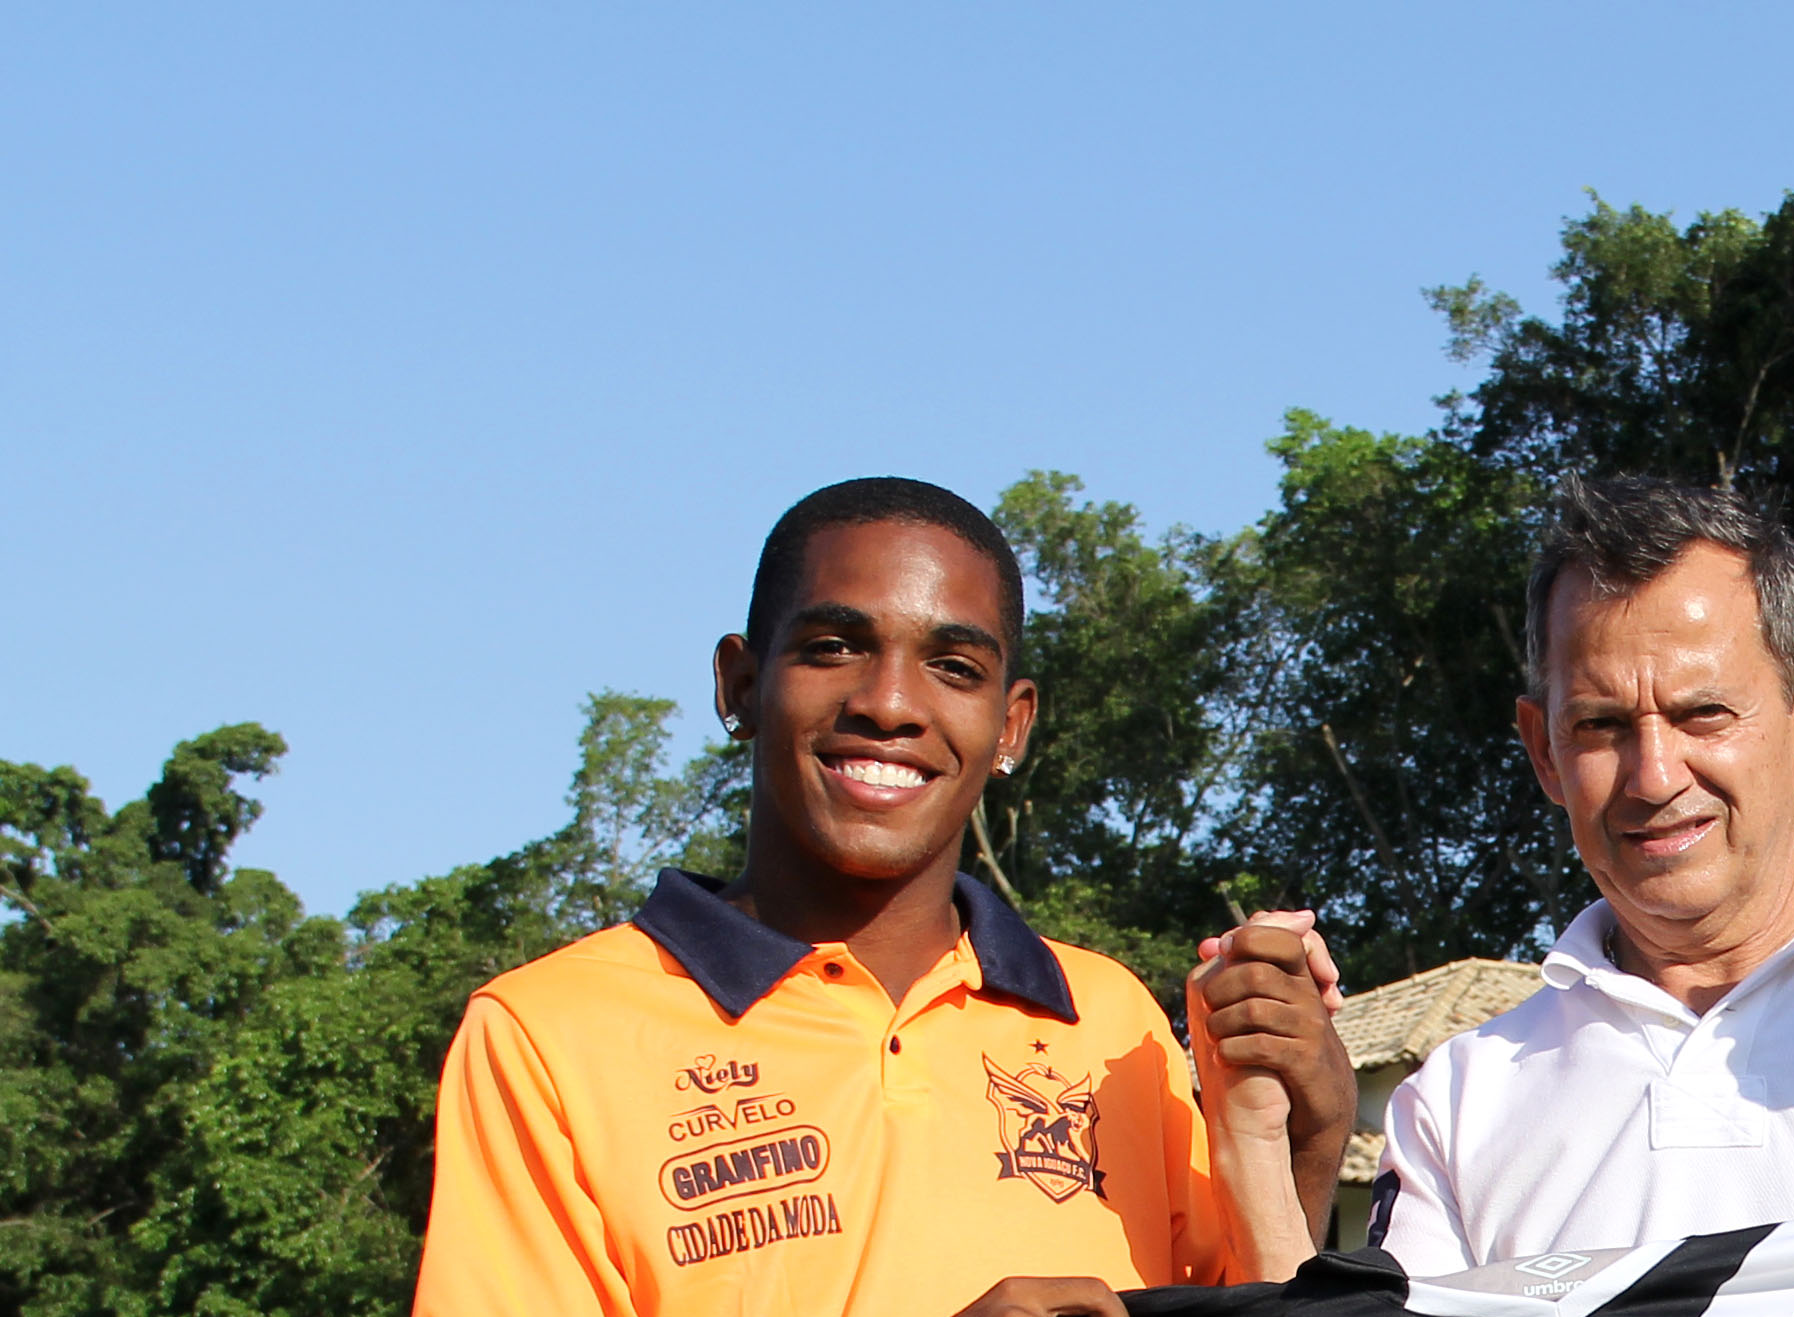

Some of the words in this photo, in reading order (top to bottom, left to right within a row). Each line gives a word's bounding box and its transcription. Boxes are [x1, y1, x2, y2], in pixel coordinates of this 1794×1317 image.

[674, 1055, 759, 1094] Niely
[668, 1092, 796, 1142] CURVELO
[672, 1135, 821, 1201] GRANFINO
[667, 1210, 750, 1267] CIDADE
[748, 1203, 783, 1249] DA
[780, 1193, 843, 1239] MODA
